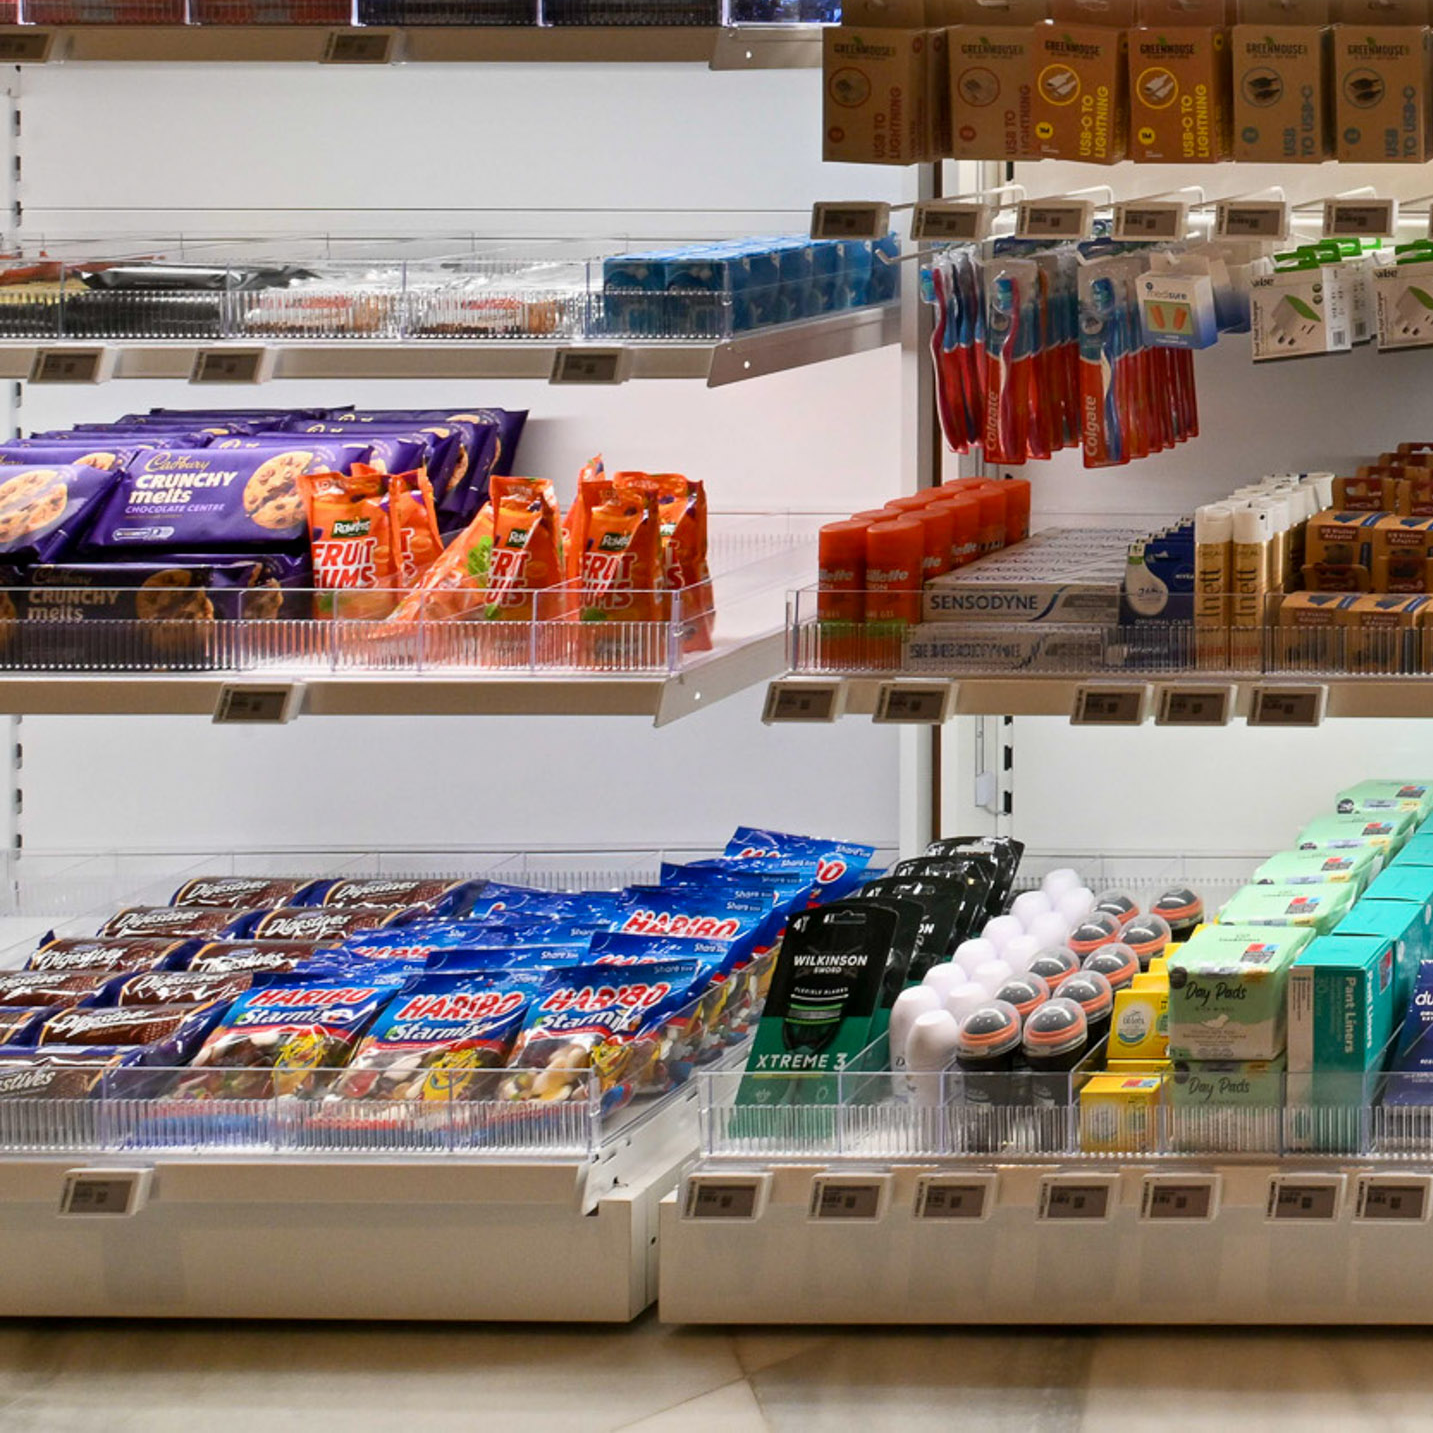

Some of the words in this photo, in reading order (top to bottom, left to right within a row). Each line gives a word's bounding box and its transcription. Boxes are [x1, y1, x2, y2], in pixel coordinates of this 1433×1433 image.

[1094, 85, 1109, 158] LIGHTNING
[986, 391, 998, 451] Colgate
[1085, 395, 1098, 457] Colgate
[144, 452, 210, 473] Cadbury
[135, 471, 238, 488] CRUNCHY
[128, 489, 192, 505] melts
[125, 503, 187, 514] CHOCOLATE
[188, 503, 226, 512] CENTRE
[28, 590, 119, 605] CRUNCHY
[930, 594, 1039, 611] SENSODYNE
[27, 605, 84, 622] melts
[793, 955, 868, 967] WILKINSON
[813, 966, 842, 975] SWORD
[247, 987, 379, 1008] HARIBO
[538, 982, 672, 1014] HARIBO
[1185, 982, 1211, 1005] Day
[1215, 983, 1248, 1001] Pads
[1344, 975, 1356, 1009] Pant
[398, 992, 526, 1021] HARIBO
[541, 1007, 643, 1033] Starmix
[393, 1021, 491, 1042] Starmix
[1344, 1012, 1355, 1055] Liners
[756, 1054, 830, 1069] XTREME
[833, 1052, 848, 1070] 3
[1188, 1076, 1214, 1099] Day
[1217, 1078, 1250, 1095] Pads
